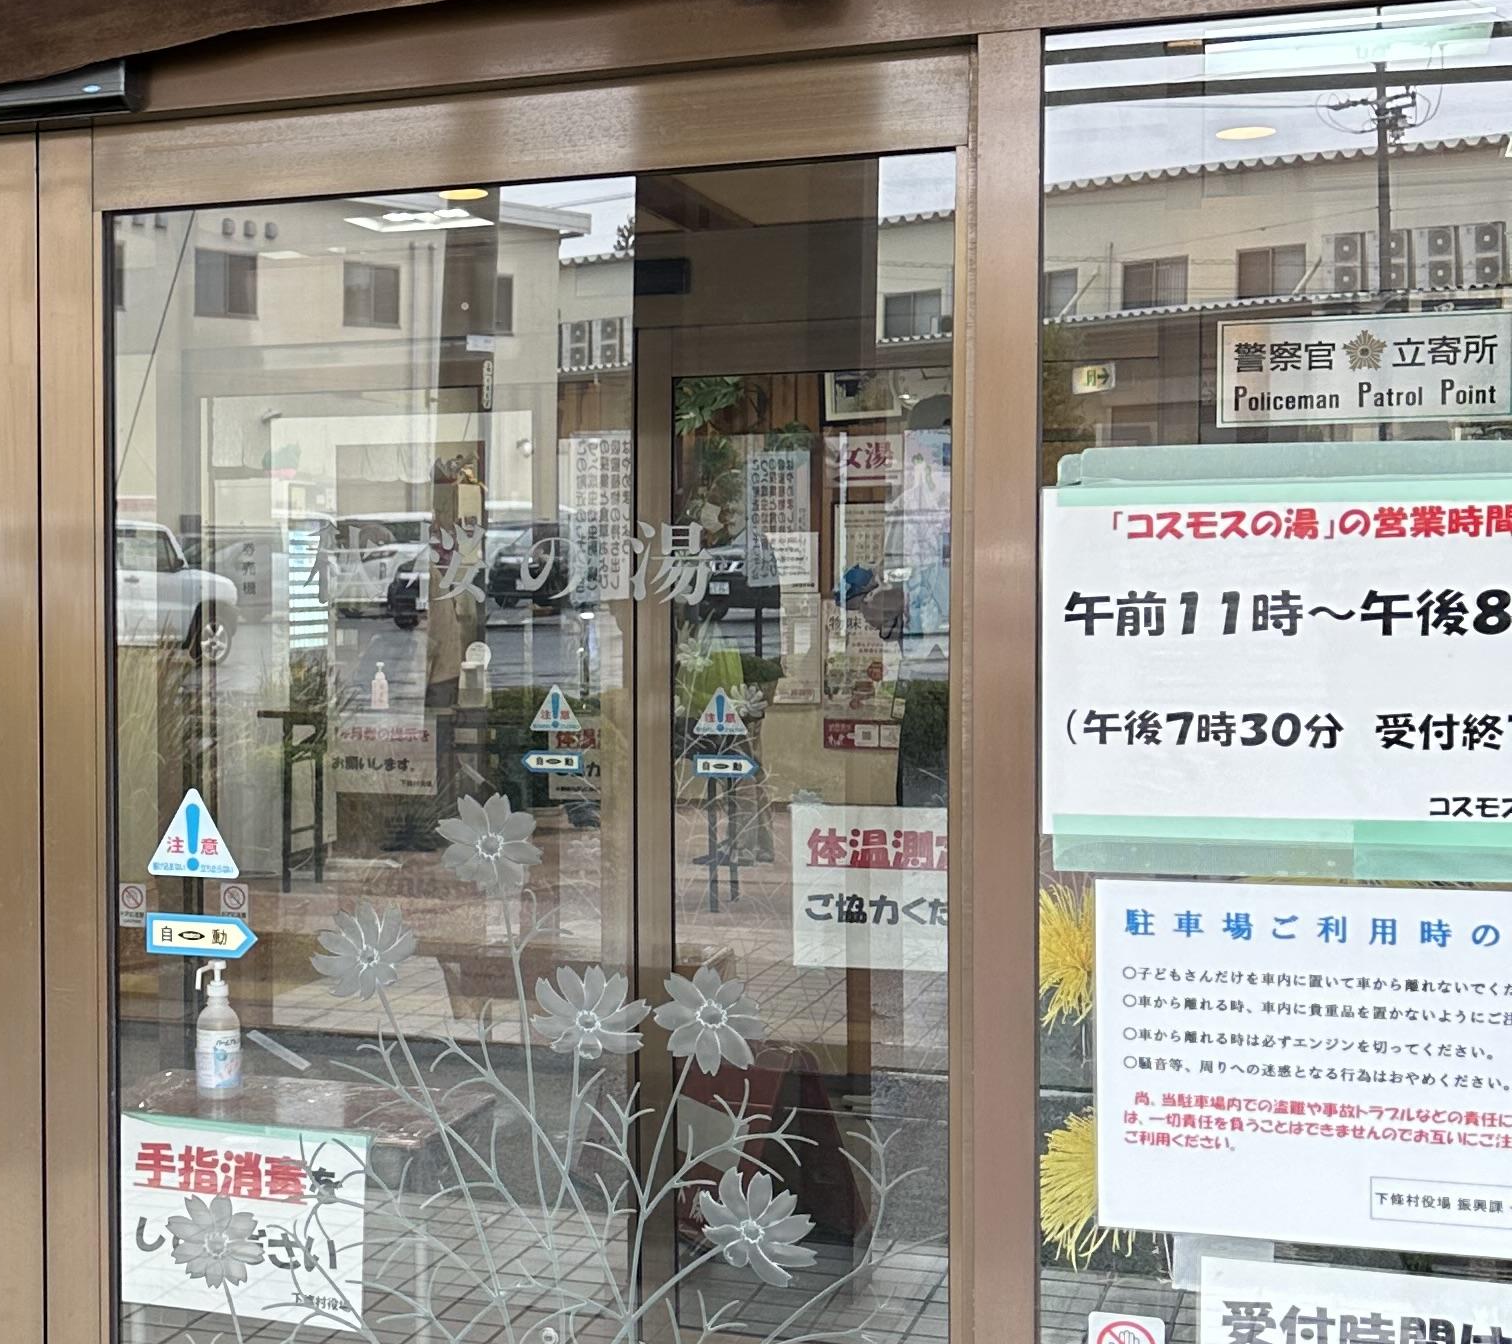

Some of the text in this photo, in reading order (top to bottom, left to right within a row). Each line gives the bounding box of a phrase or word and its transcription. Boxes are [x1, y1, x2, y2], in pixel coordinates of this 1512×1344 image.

[1233, 334, 1498, 374] 警察官 立寄所
[1233, 379, 1497, 413] Policeman Patrol Point
[1375, 712, 1512, 751] 受付終
[166, 836, 219, 855] 注意
[807, 827, 947, 868] 体温測
[161, 925, 228, 945] 自動
[1125, 908, 1501, 948] 駐車場ご利用時の
